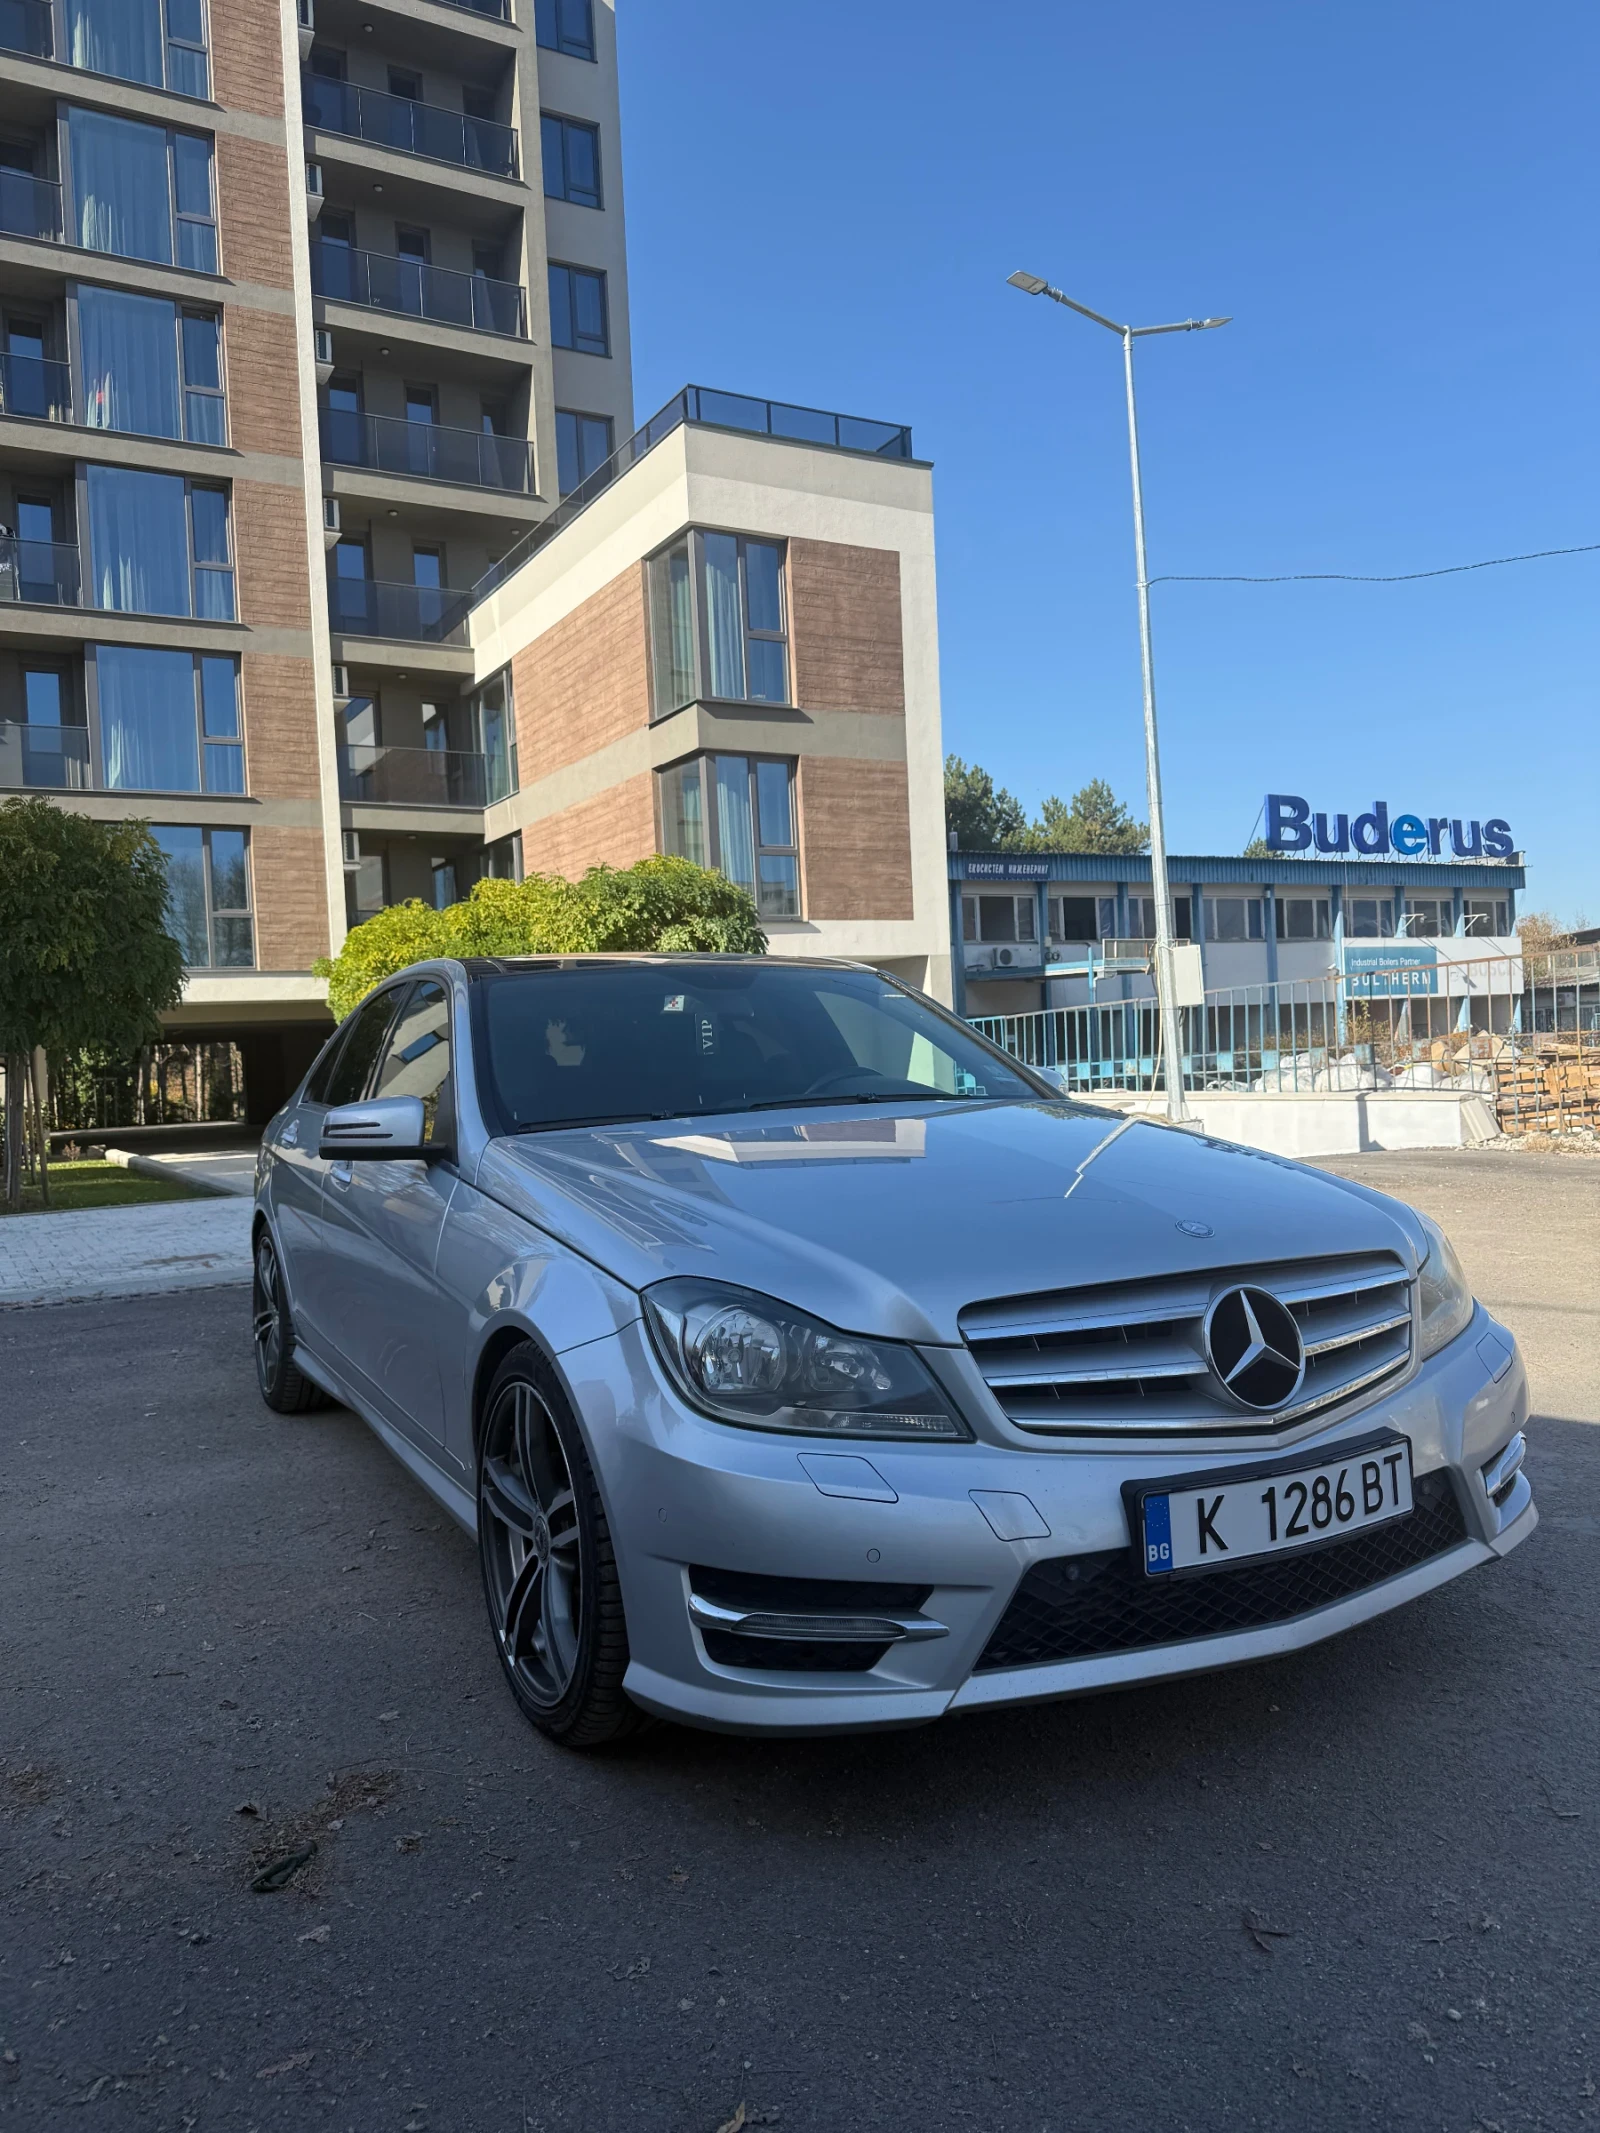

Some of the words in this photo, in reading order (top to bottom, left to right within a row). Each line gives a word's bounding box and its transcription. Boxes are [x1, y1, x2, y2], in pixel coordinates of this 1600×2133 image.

[1264, 793, 1514, 858] Buderus
[968, 863, 1004, 874] ЕКОСИСТЕМ
[1351, 958, 1378, 967] Industrial
[1379, 958, 1399, 966] Boilers
[1400, 957, 1421, 966] Partner
[701, 1019, 713, 1050] VIP
[1148, 1542, 1170, 1562] BG
